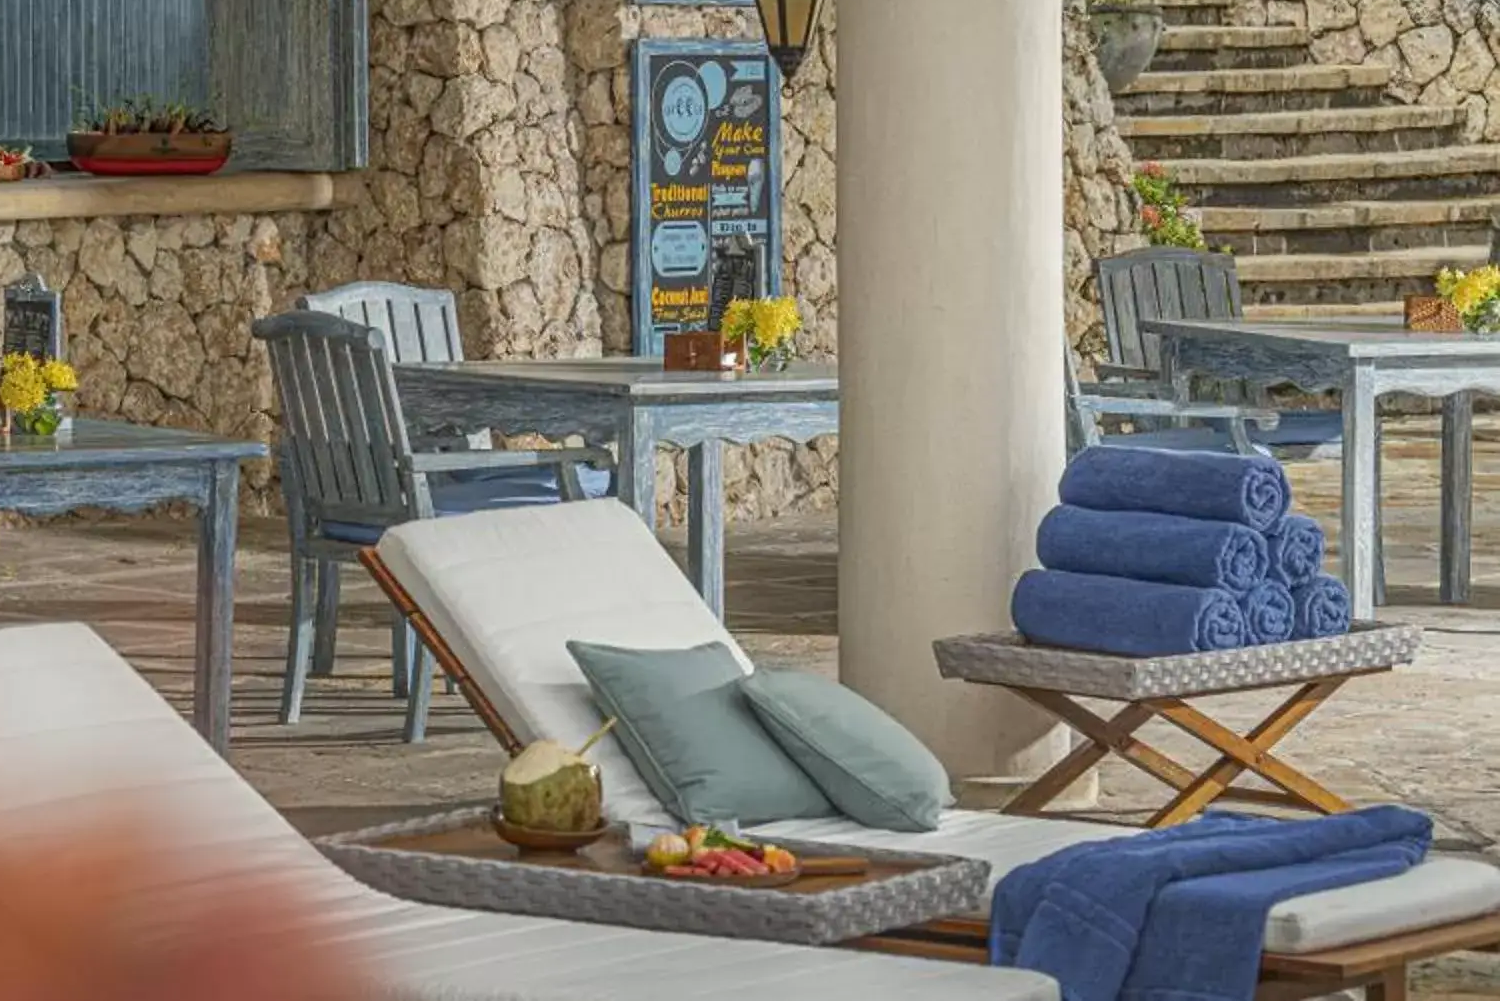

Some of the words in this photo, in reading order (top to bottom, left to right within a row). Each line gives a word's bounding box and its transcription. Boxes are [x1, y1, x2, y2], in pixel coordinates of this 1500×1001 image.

[712, 120, 764, 149] Make
[651, 183, 708, 203] Traditional
[651, 202, 704, 219] Churros
